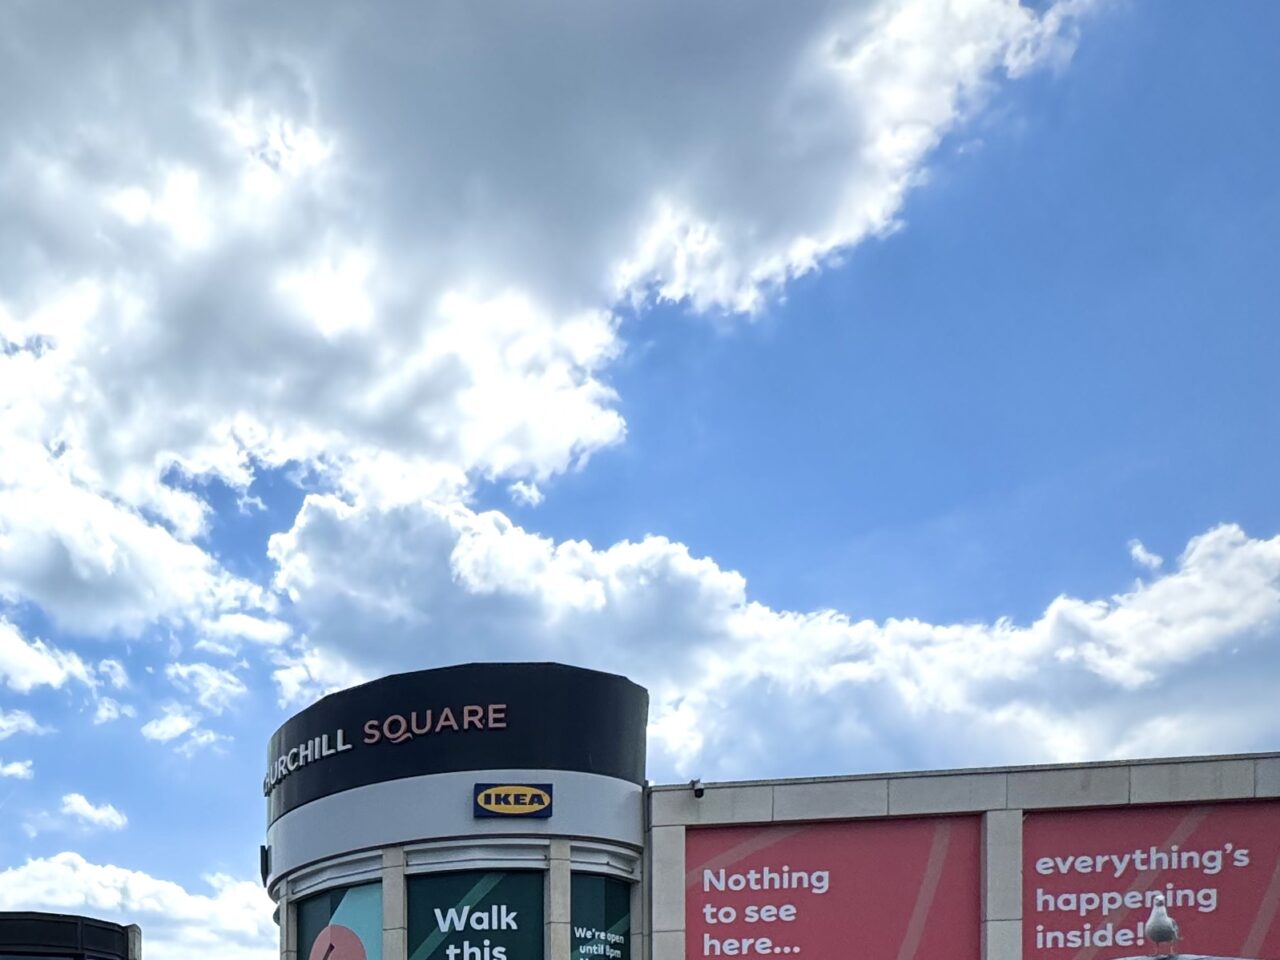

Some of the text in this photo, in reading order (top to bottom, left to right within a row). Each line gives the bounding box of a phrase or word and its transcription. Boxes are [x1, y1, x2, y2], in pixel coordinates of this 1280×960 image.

[363, 704, 507, 744] SQUARE
[484, 793, 546, 806] IKEA
[1035, 844, 1250, 878] everything's
[703, 866, 830, 894] Nothing
[434, 905, 518, 933] Walk
[703, 902, 797, 924] to see
[574, 926, 624, 944] We're open
[703, 934, 801, 957] here...
[1035, 923, 1145, 949] inside!
[579, 944, 604, 955] until
